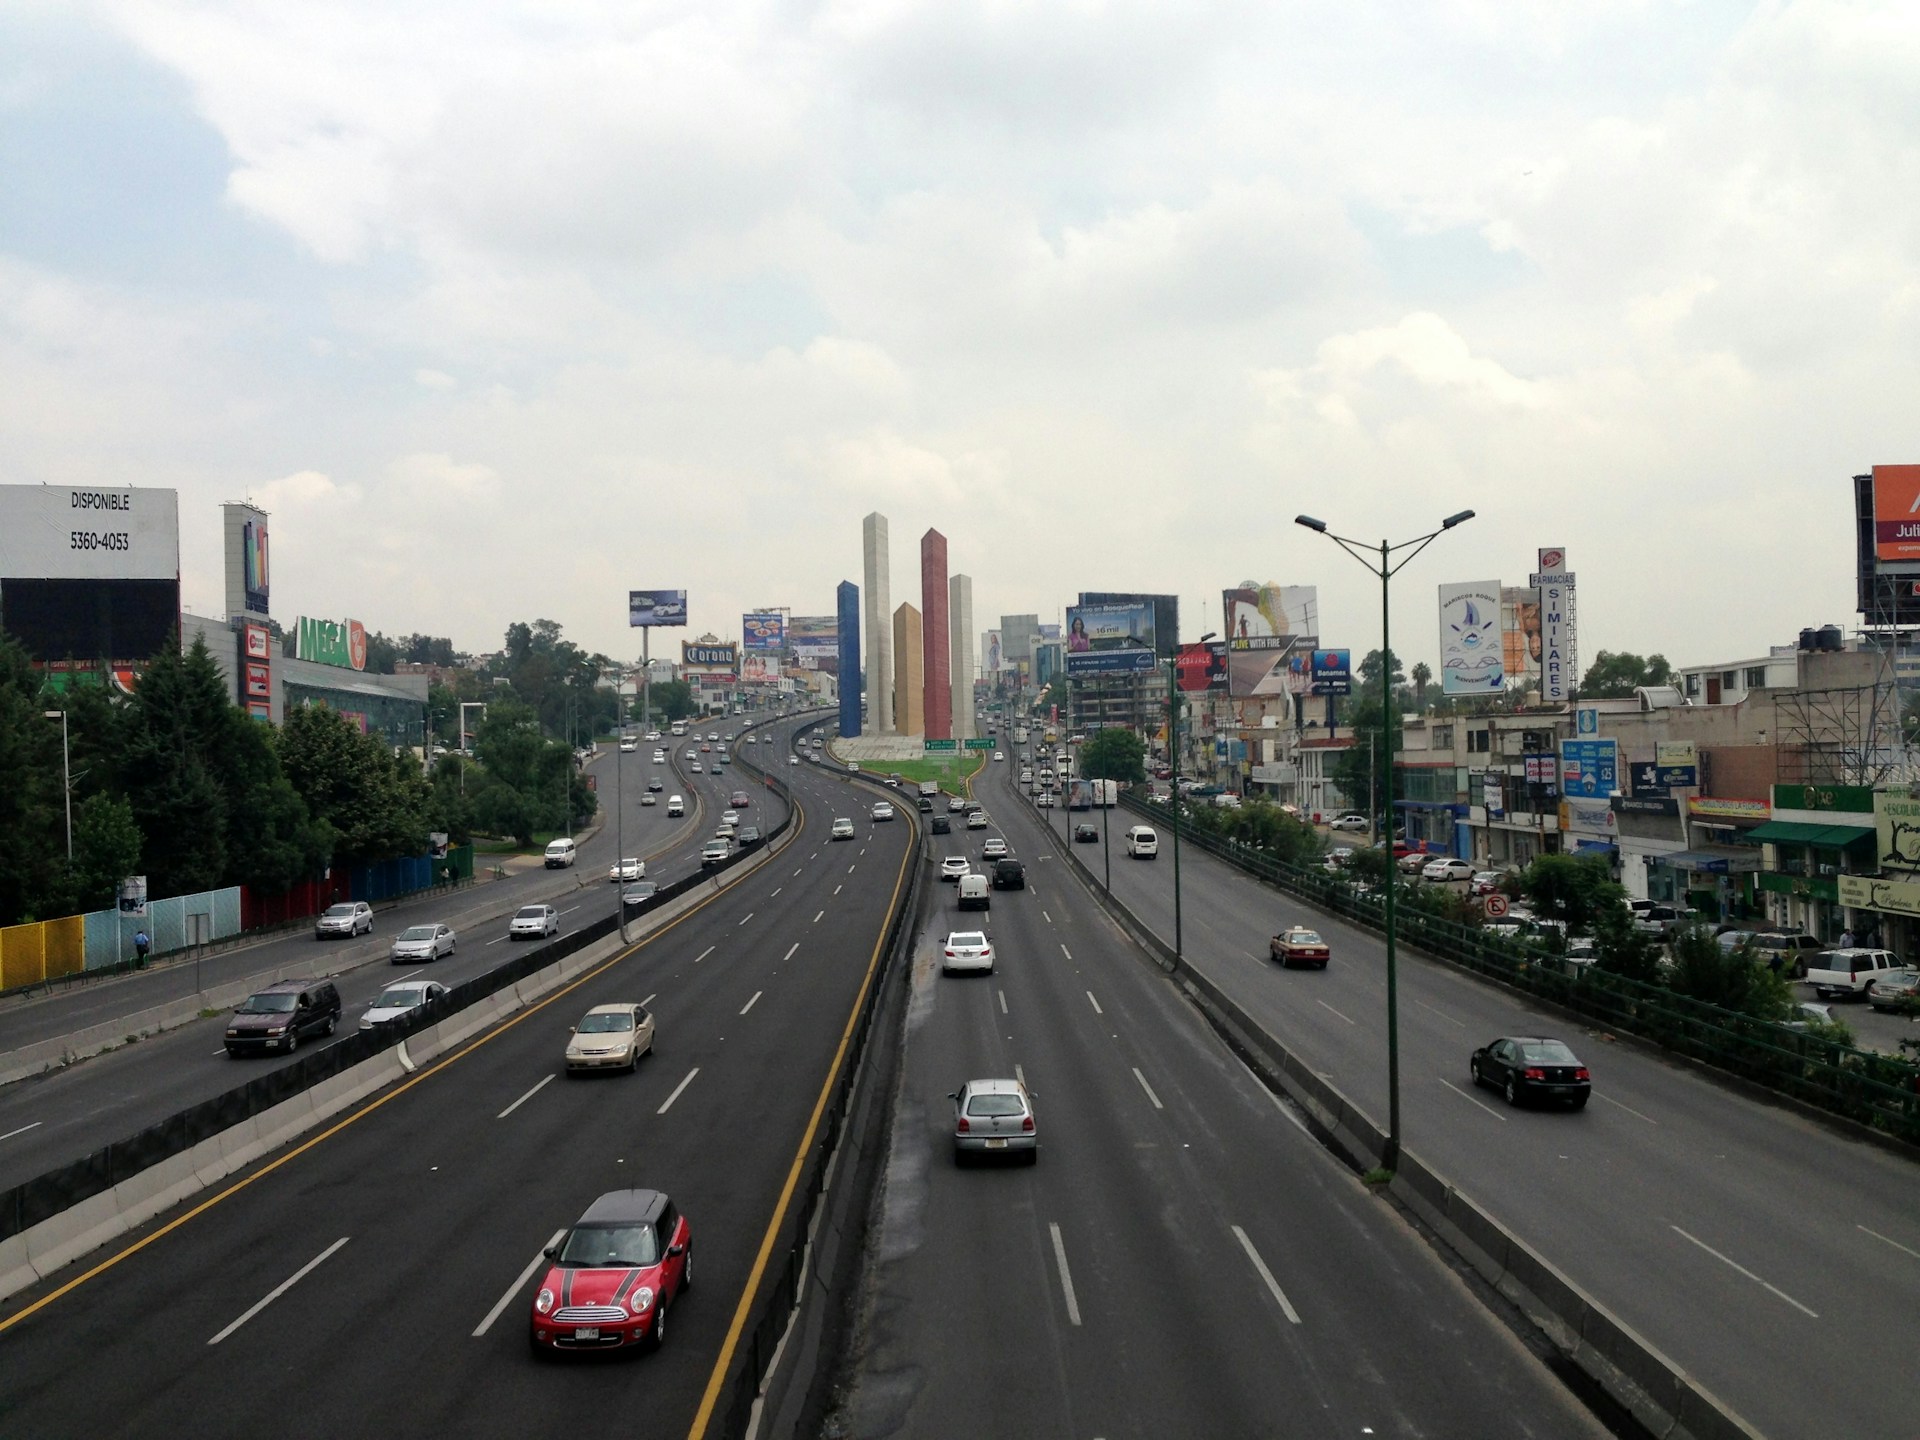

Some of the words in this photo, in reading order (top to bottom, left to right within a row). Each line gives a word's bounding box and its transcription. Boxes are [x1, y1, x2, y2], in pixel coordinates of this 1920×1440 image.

[72, 491, 130, 511] DISPONIBLE
[71, 531, 129, 551] 5360-4053
[1533, 574, 1575, 584] FARMACIAS
[1443, 594, 1473, 609] MARISCOS
[1475, 593, 1496, 604] ROQUE
[301, 615, 352, 669] MEGA
[1231, 639, 1249, 650] #LIVE
[1249, 639, 1266, 649] WITH
[1267, 638, 1281, 648] FIRE
[1547, 589, 1561, 697] SIMILARES
[687, 647, 733, 663] Corona
[1455, 674, 1492, 684] BIENVENIDOS
